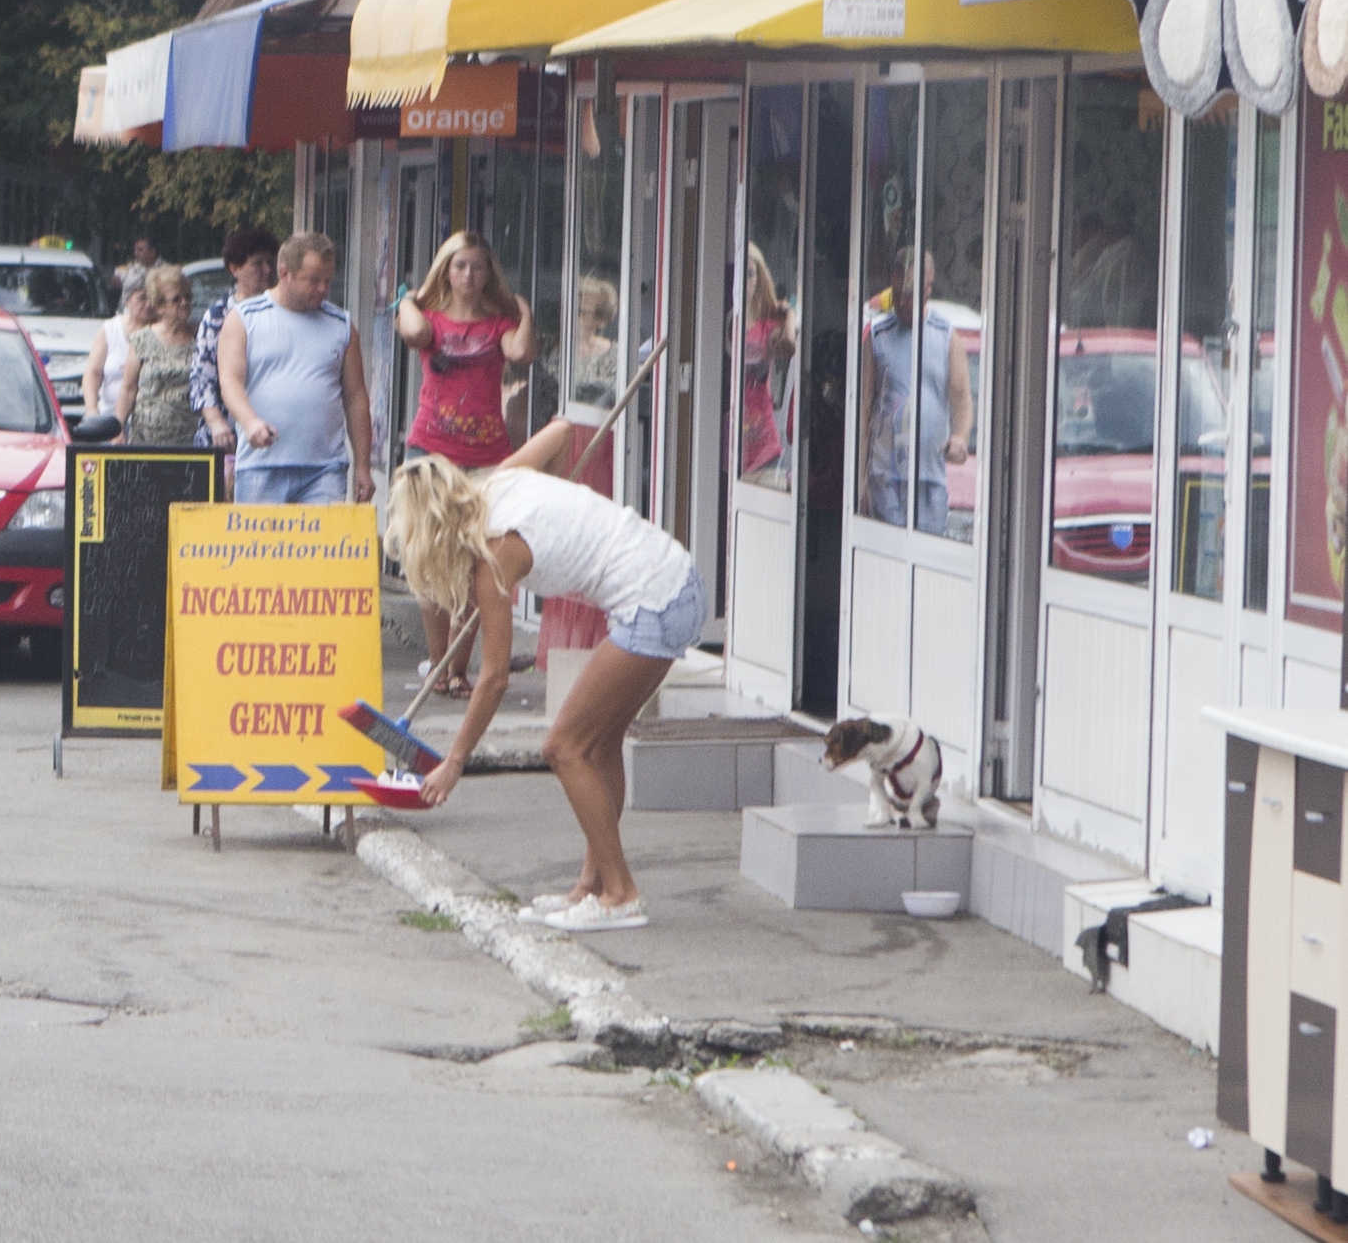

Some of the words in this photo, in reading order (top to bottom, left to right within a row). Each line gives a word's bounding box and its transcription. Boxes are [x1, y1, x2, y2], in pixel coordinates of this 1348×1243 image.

[406, 107, 506, 134] orange
[226, 511, 321, 533] Bucuria
[179, 535, 370, 569] cumpărătorului
[216, 642, 337, 676] CURELE
